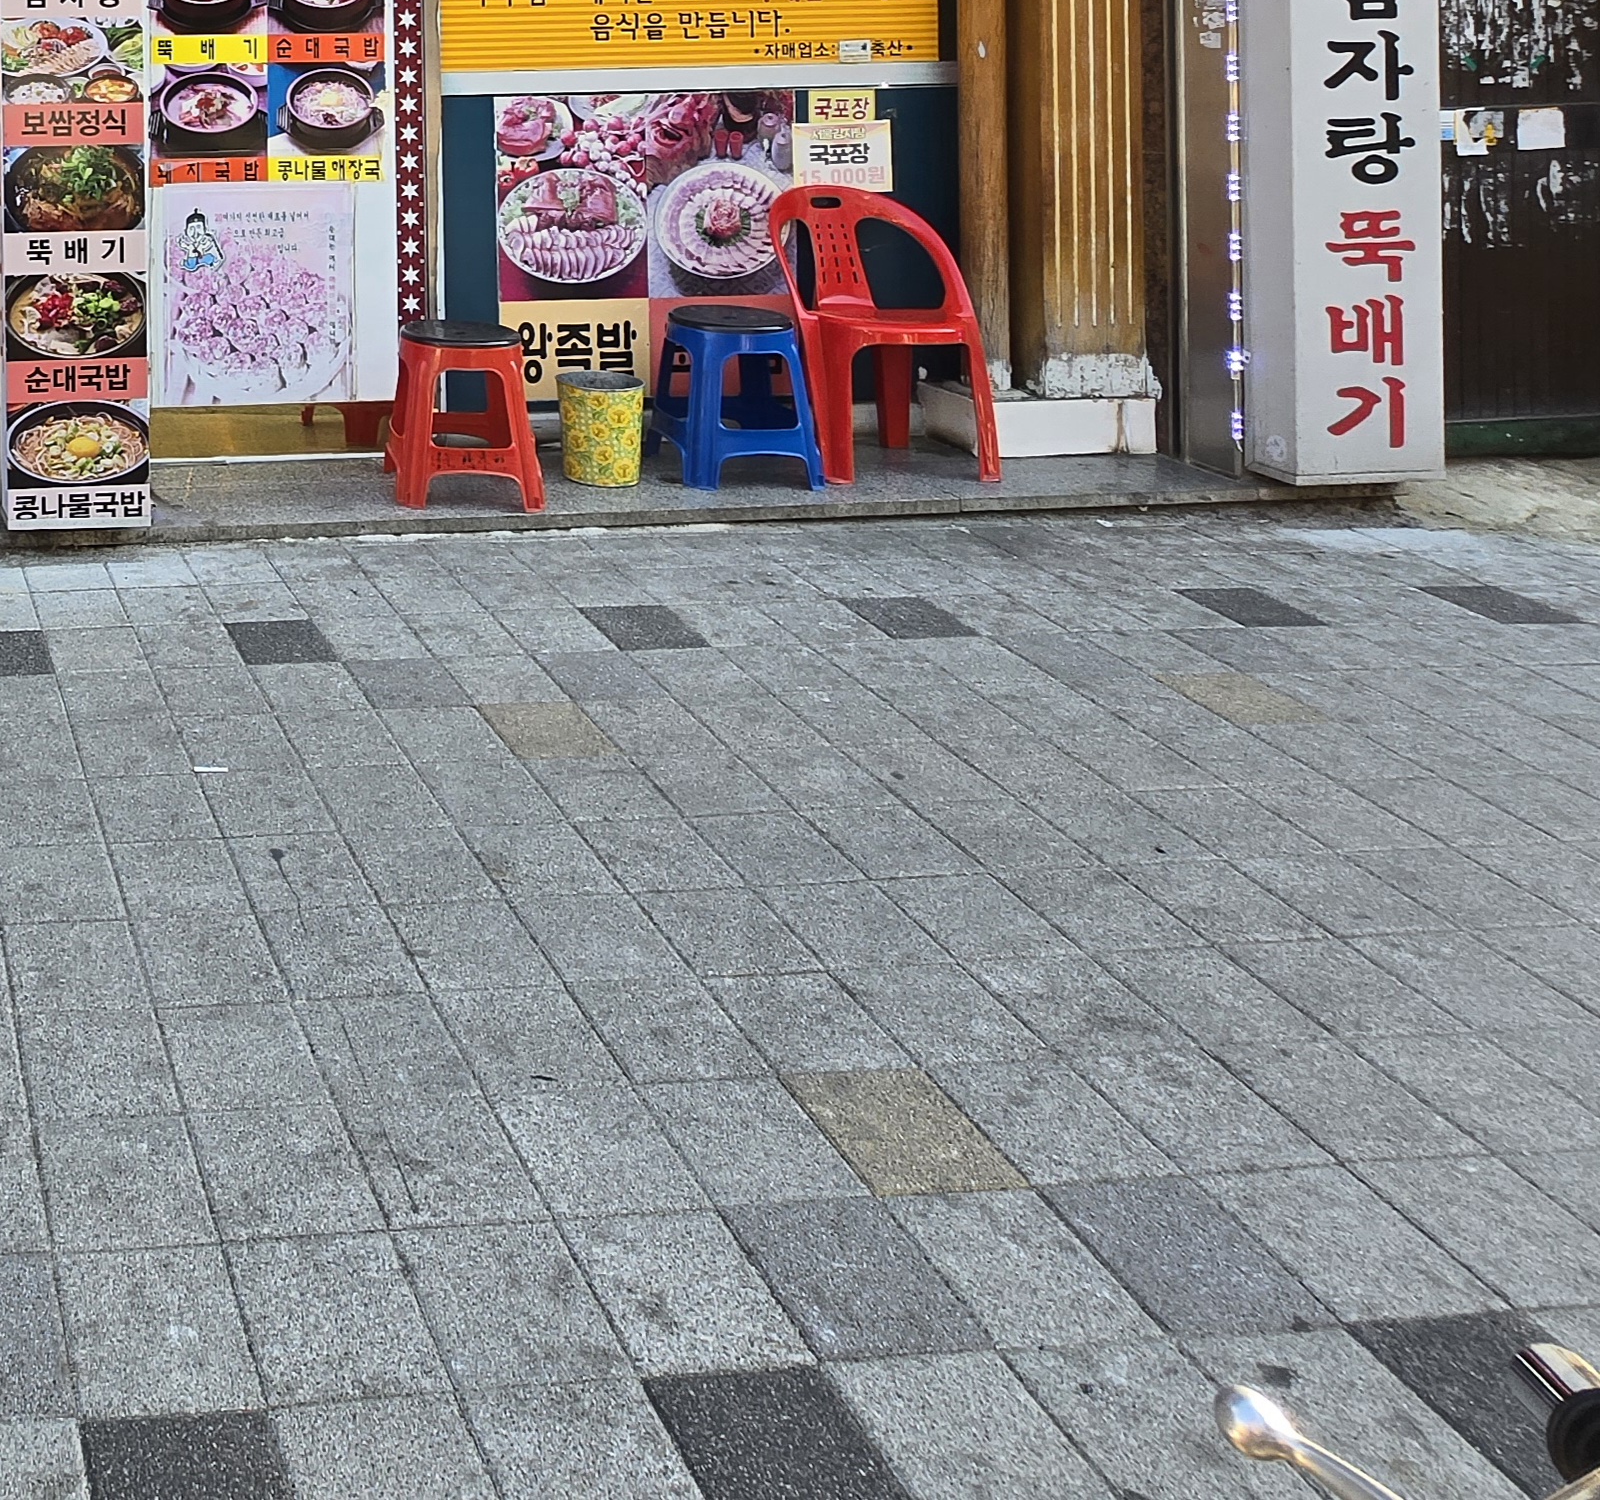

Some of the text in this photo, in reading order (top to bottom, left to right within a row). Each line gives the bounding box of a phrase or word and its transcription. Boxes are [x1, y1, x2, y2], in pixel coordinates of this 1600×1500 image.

[590, 9, 791, 41] 음식을 만듭니다.
[157, 37, 380, 60] 뚝배기 순대국밥
[814, 97, 870, 120] 국포장
[21, 110, 128, 137] 보쌈정식
[809, 142, 871, 165] 국포장
[26, 236, 126, 265] 뚝배기
[1325, 210, 1416, 448] 뚝배기
[517, 320, 638, 384] 왕족발
[24, 364, 131, 393] 순대국밥
[13, 491, 145, 521] 콩나물국밥
